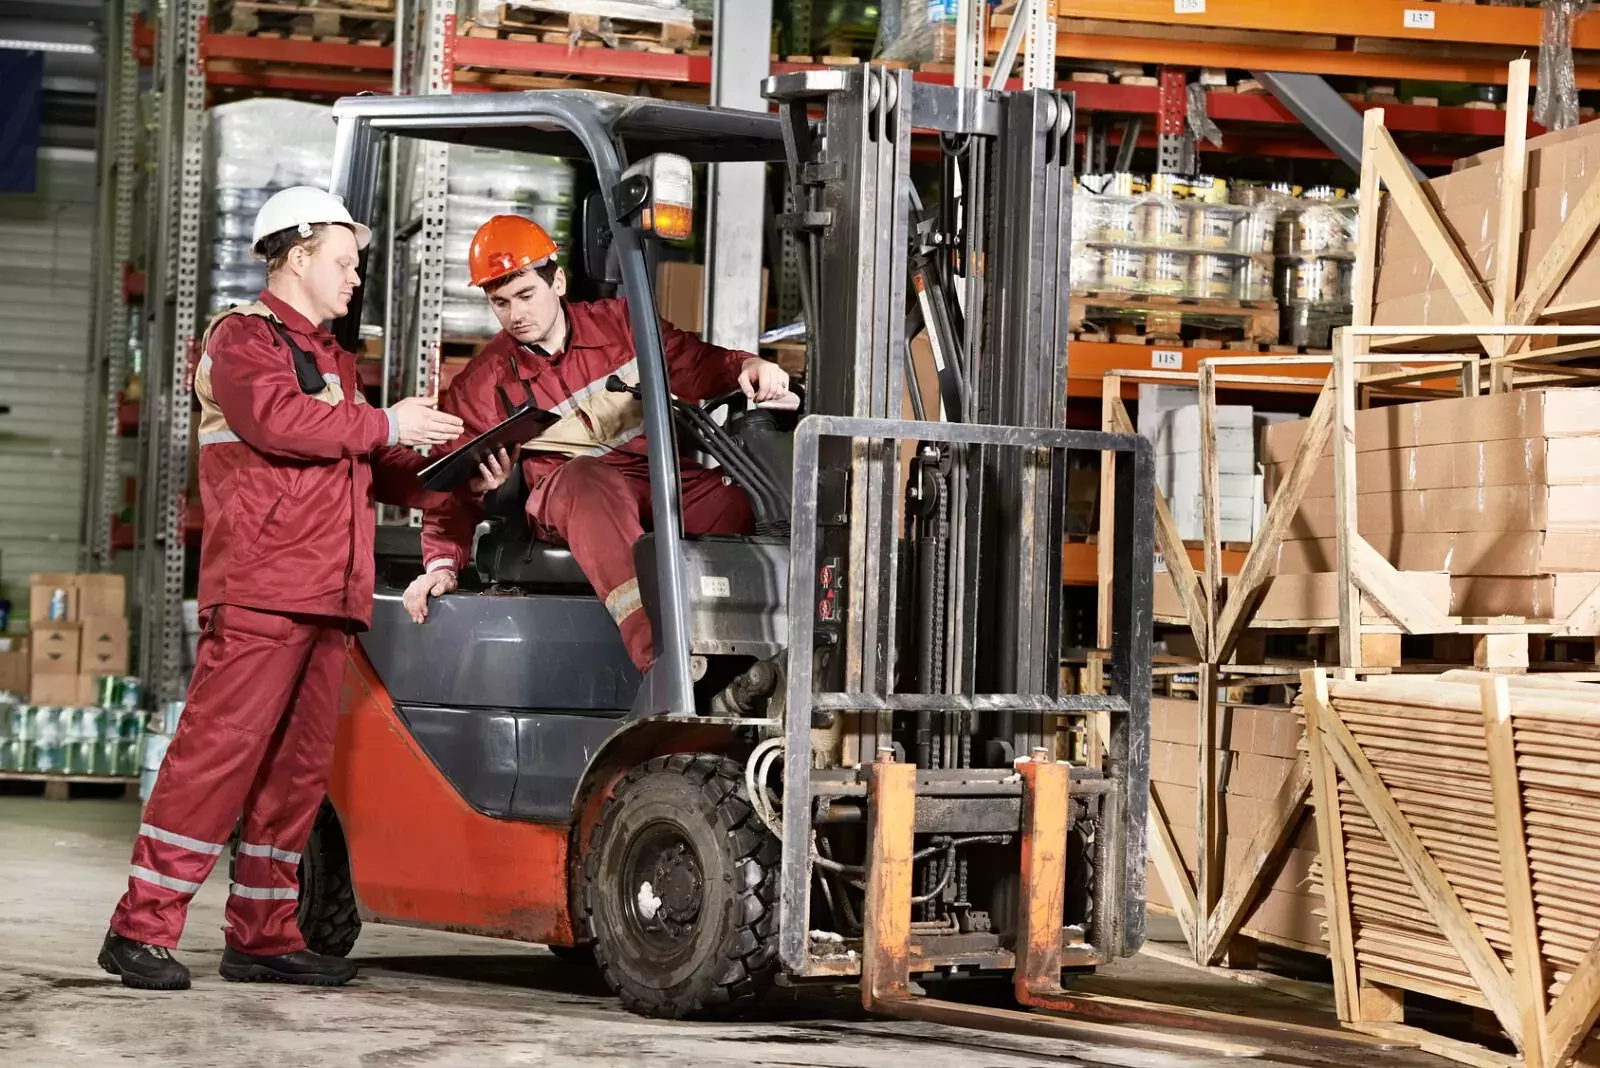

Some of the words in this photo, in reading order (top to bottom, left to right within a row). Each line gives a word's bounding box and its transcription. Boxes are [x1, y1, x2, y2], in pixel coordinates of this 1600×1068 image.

[1412, 13, 1429, 23] 137
[1159, 354, 1175, 364] 115
[1154, 555, 1164, 564] 10
